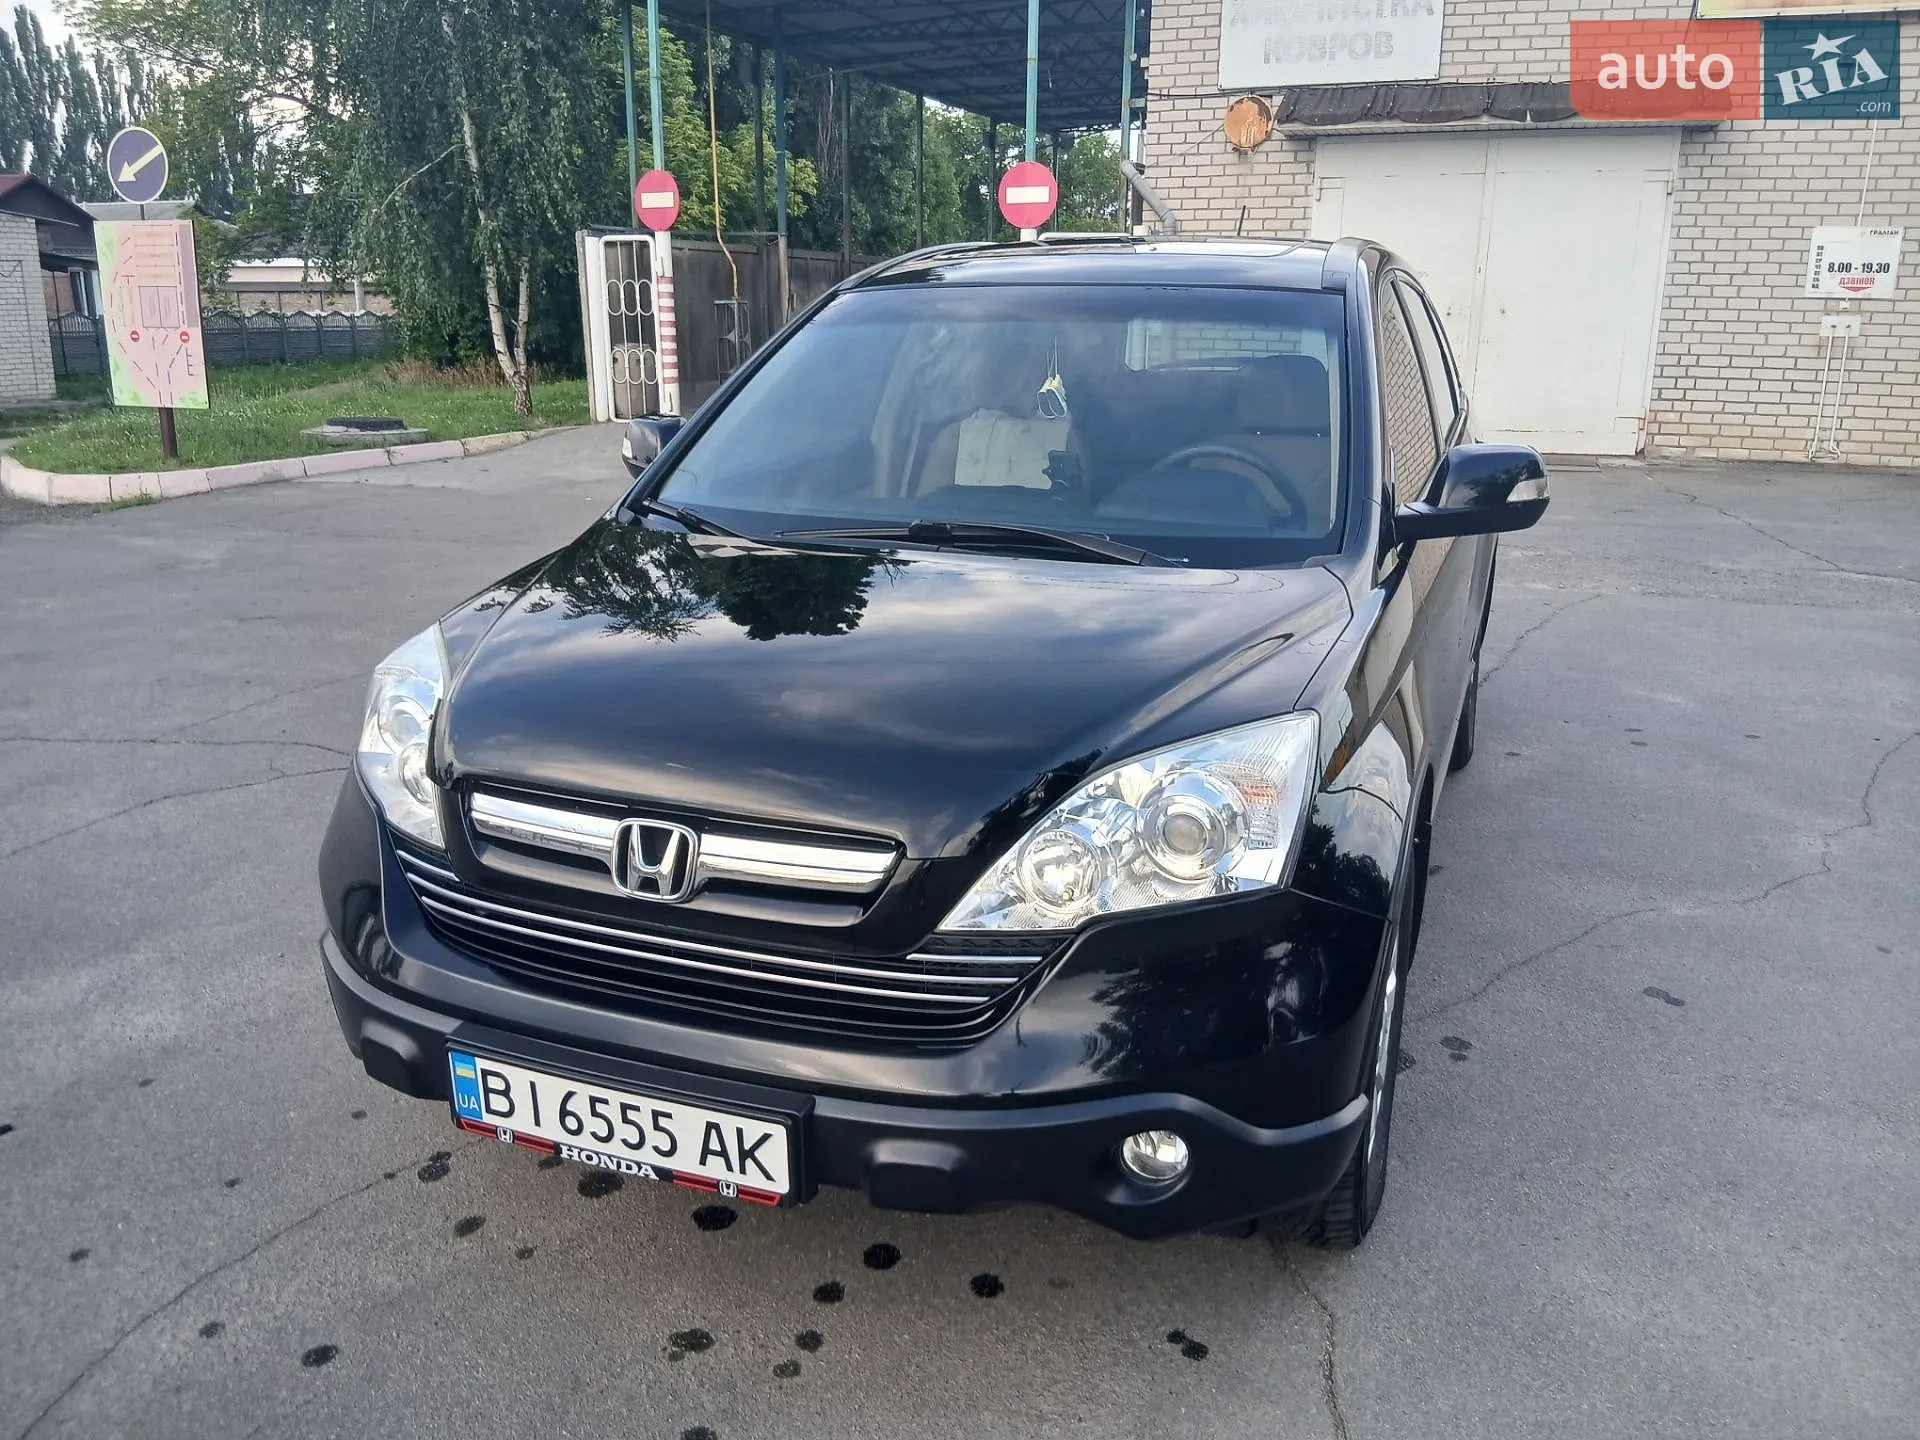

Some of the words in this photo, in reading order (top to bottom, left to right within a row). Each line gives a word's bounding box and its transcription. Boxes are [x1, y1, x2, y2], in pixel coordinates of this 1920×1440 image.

[1263, 31, 1395, 65] КОВРОВ
[1828, 262, 1852, 273] 8.00
[1861, 262, 1891, 274] 19.30
[458, 1092, 480, 1113] UA
[481, 1068, 543, 1129] BI
[558, 1089, 678, 1158] 6555
[699, 1120, 776, 1183] AK
[559, 1144, 660, 1181] HONDA
